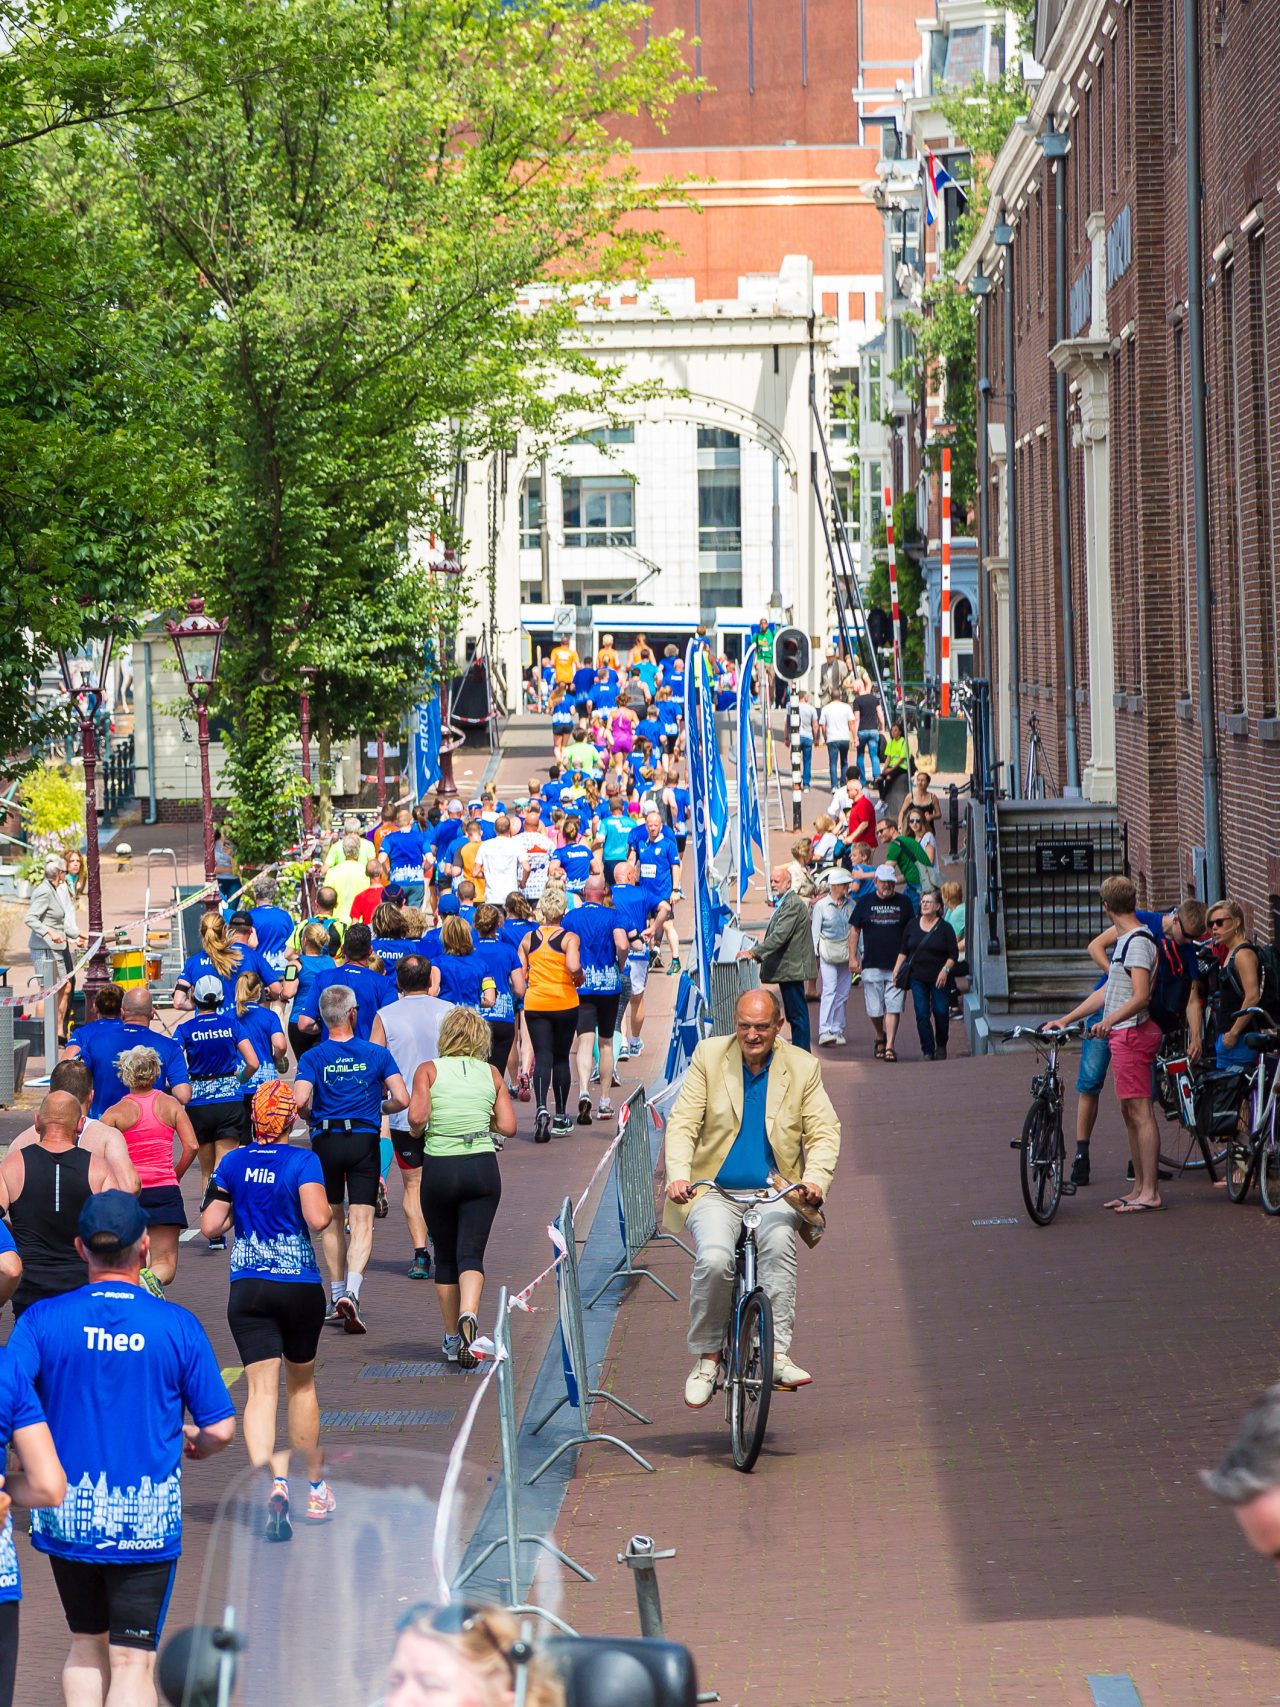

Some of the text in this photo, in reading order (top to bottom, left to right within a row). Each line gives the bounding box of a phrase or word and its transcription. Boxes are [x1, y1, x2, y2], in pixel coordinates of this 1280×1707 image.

[420, 703, 429, 752] BRO
[376, 949, 404, 960] Conny
[191, 1028, 233, 1042] Christel
[244, 1167, 276, 1184] Mila
[270, 1267, 301, 1275] BROOKS
[83, 1326, 145, 1352] Theo
[117, 1537, 165, 1551] BROOKS
